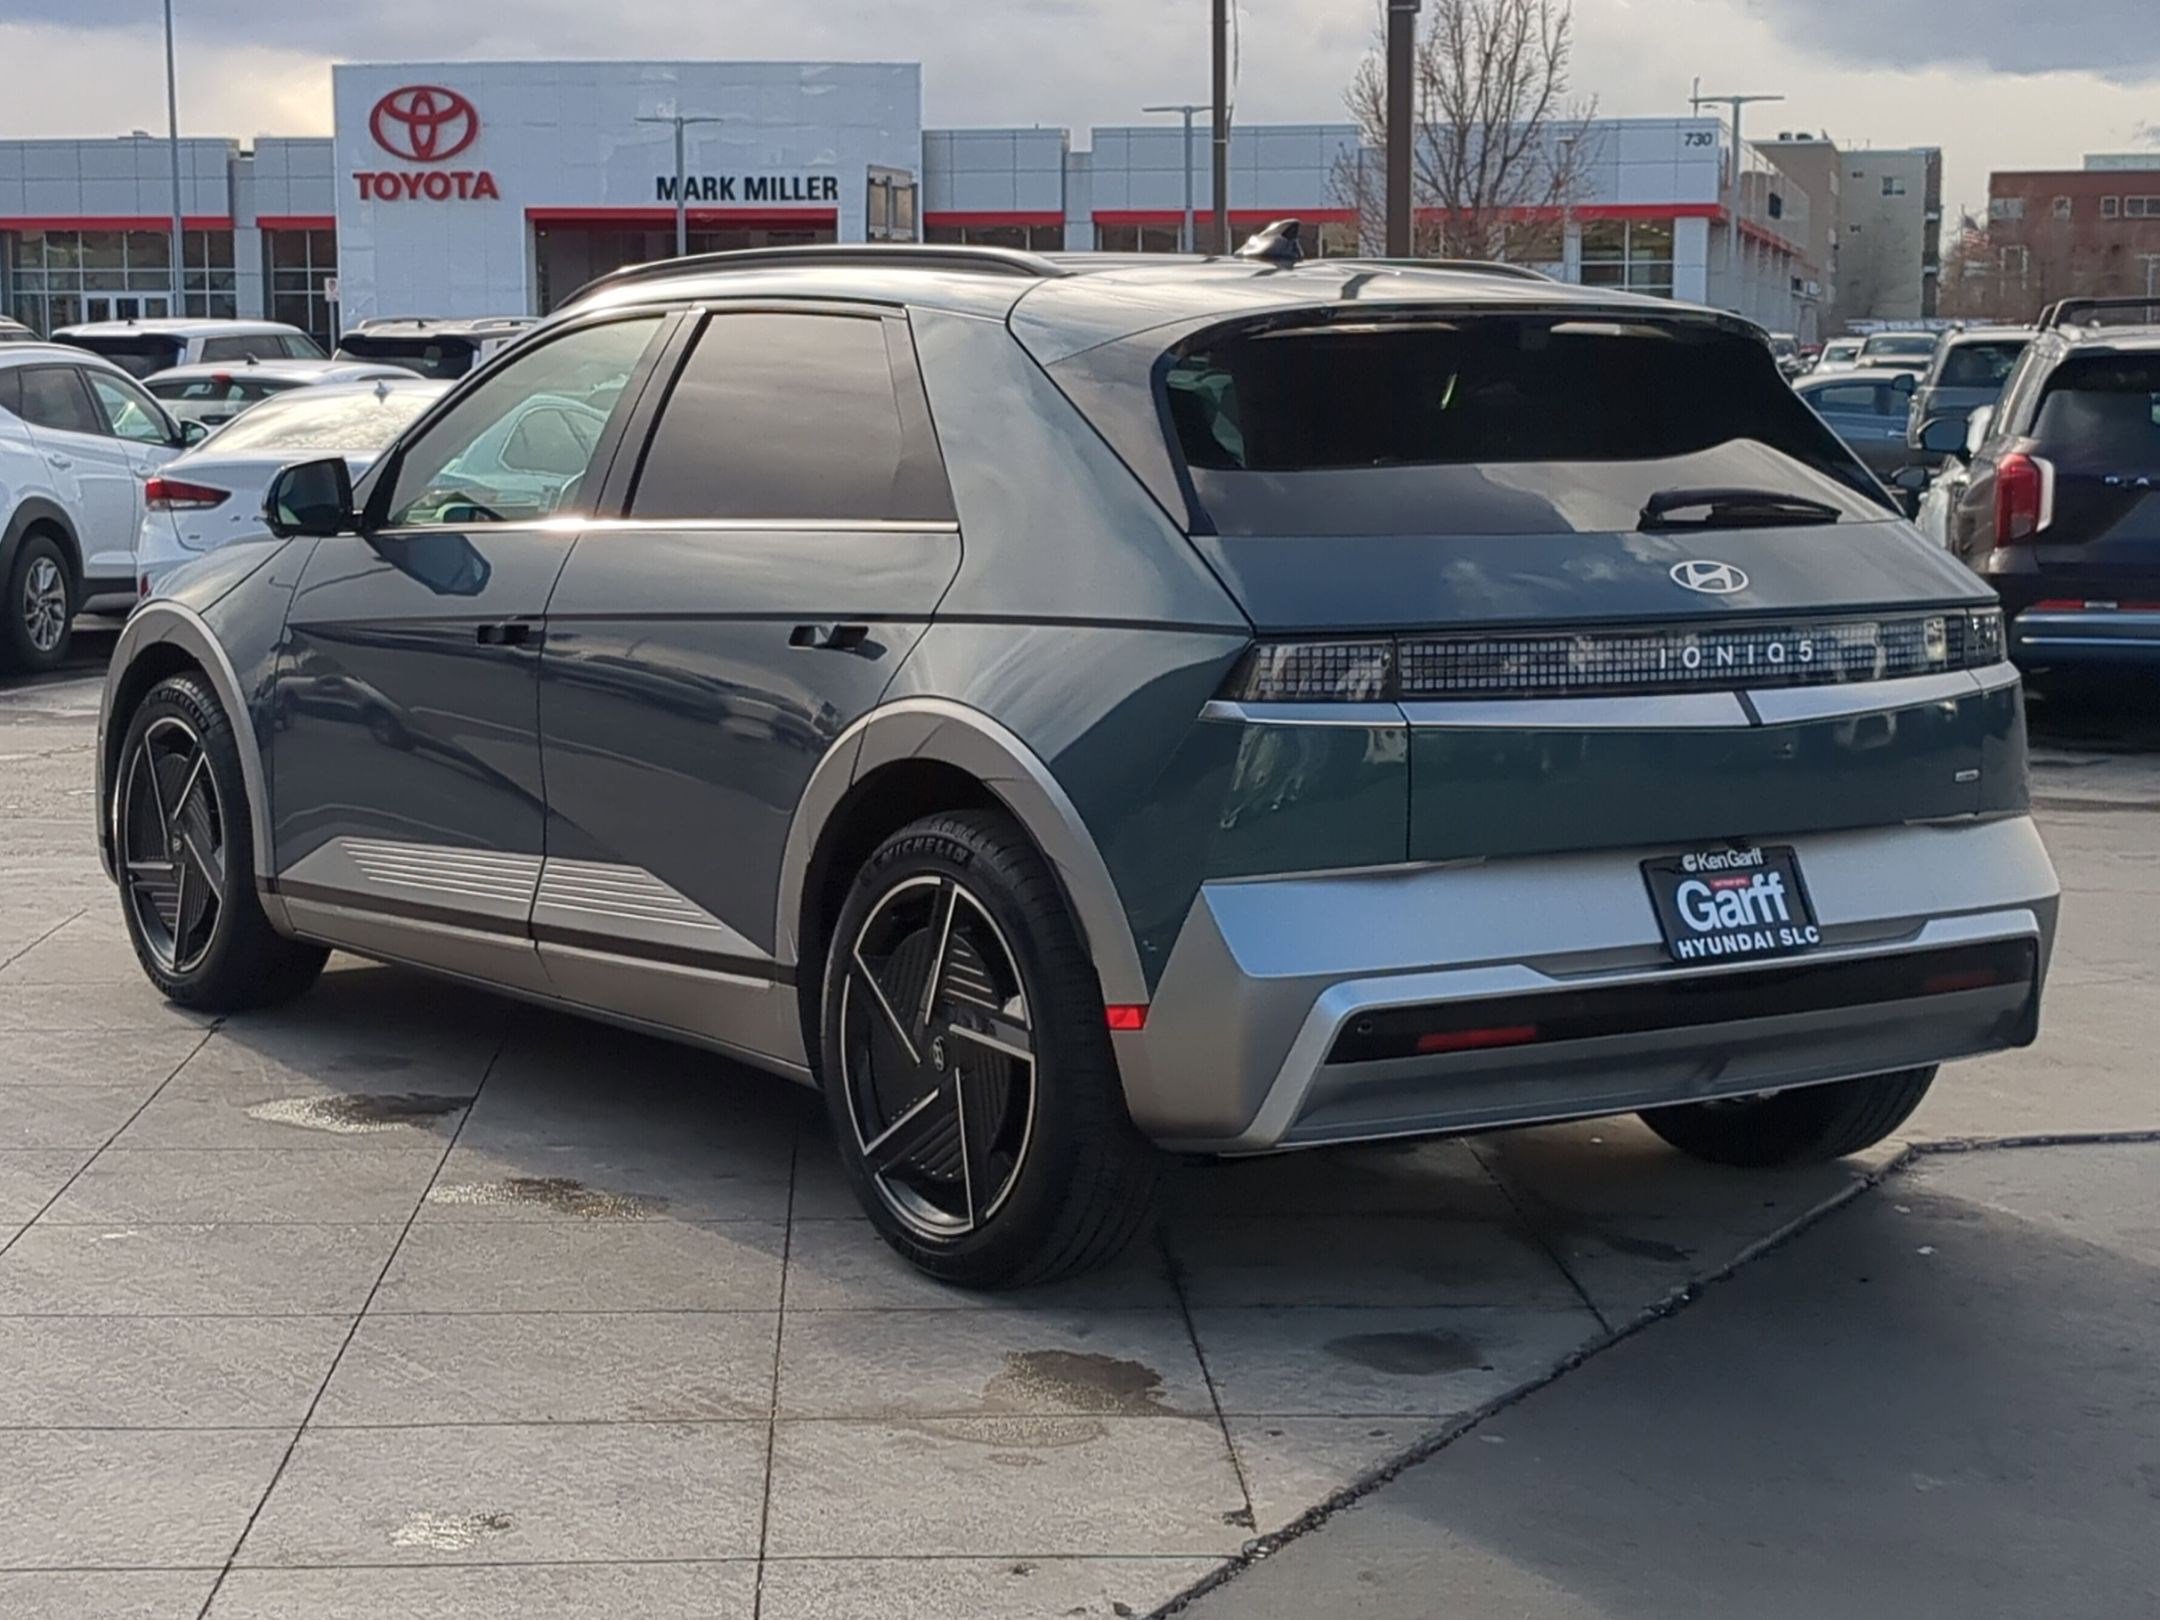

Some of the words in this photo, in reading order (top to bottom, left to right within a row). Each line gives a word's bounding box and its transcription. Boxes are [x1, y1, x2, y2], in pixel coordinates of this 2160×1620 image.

[1684, 132, 1713, 147] 730
[353, 171, 500, 201] TOYOTA
[656, 176, 736, 201] MARK
[744, 176, 839, 201] MILLER
[1676, 872, 1790, 932] Garff
[1677, 931, 1775, 959] HYUNDAI
[1779, 926, 1820, 946] SLC
